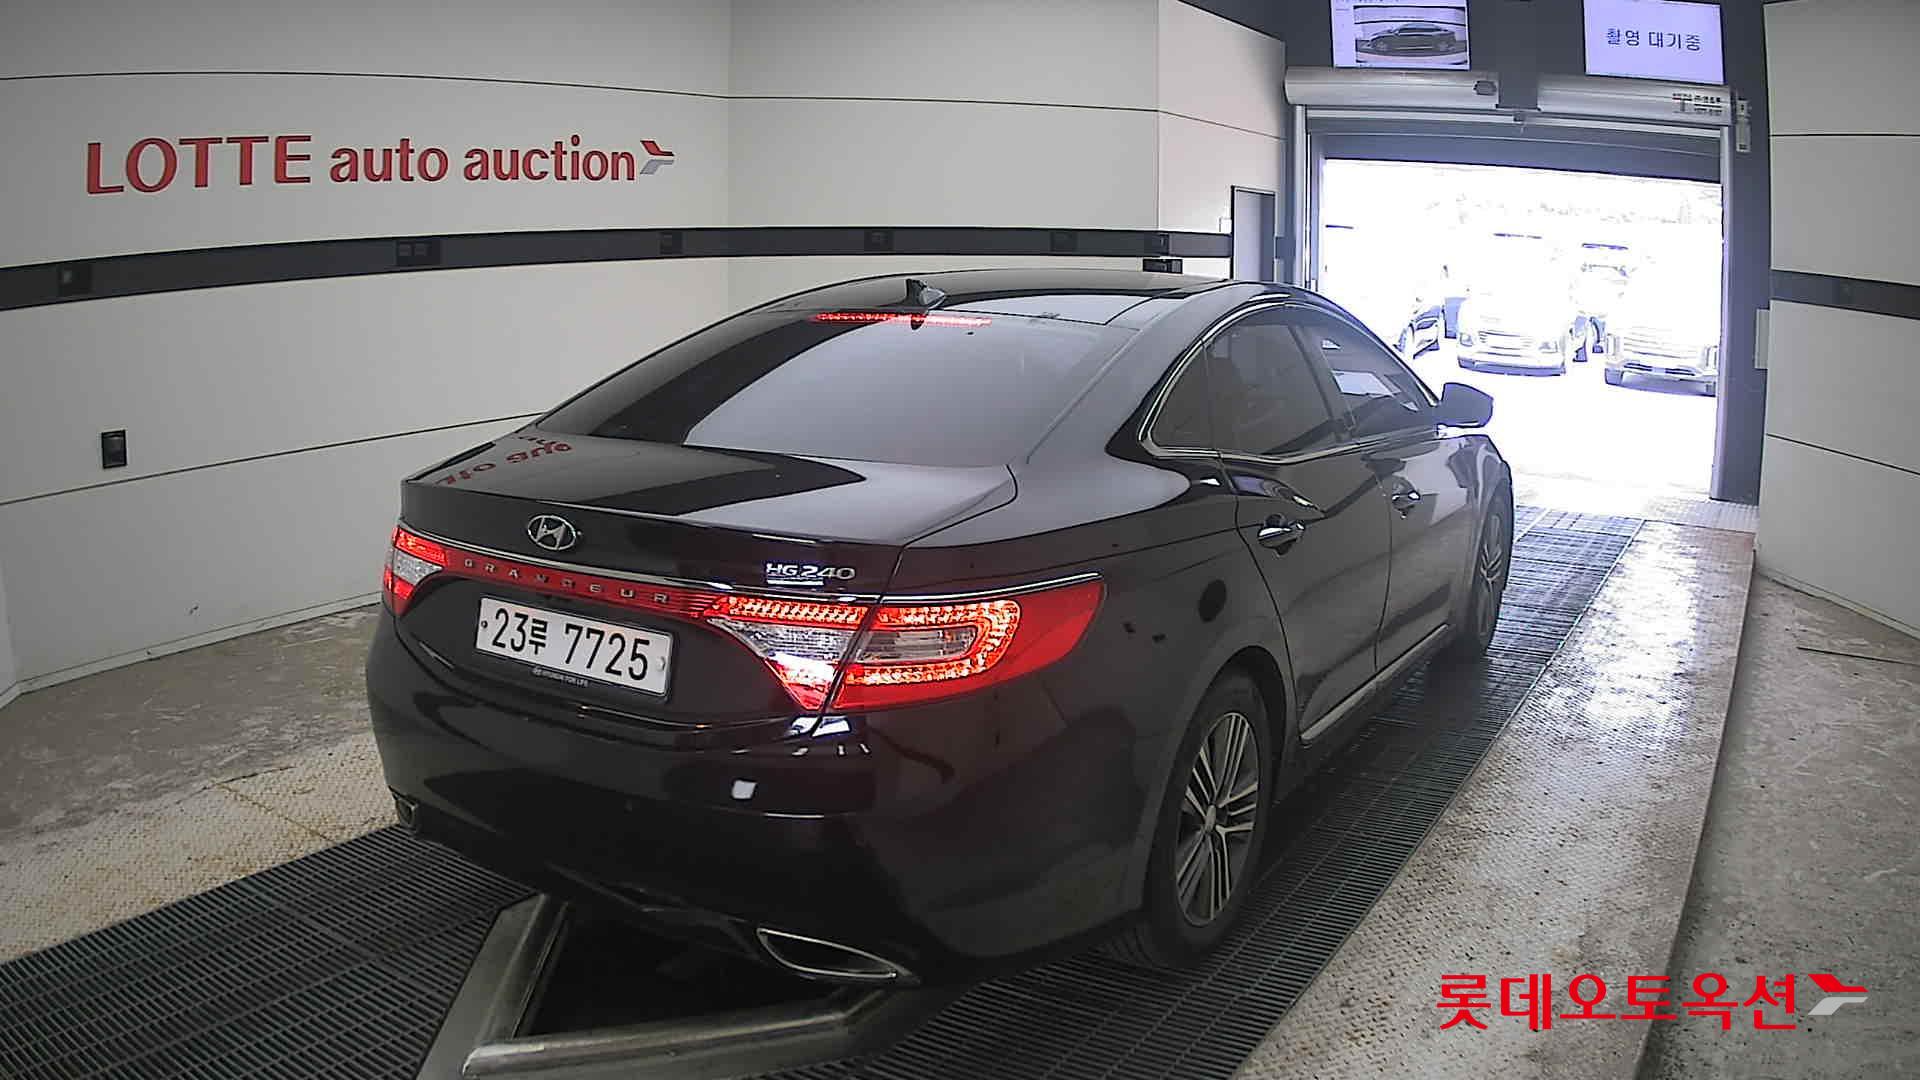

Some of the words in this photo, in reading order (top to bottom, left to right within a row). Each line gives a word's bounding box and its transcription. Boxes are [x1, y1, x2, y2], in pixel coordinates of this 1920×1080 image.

[1648, 31, 1701, 52] 대기중
[86, 135, 312, 195] LOTTE
[329, 138, 449, 183] auto
[463, 134, 637, 182] auction
[463, 558, 669, 604] GRANDEUR
[491, 607, 549, 656] 23루
[564, 622, 651, 681] 7725
